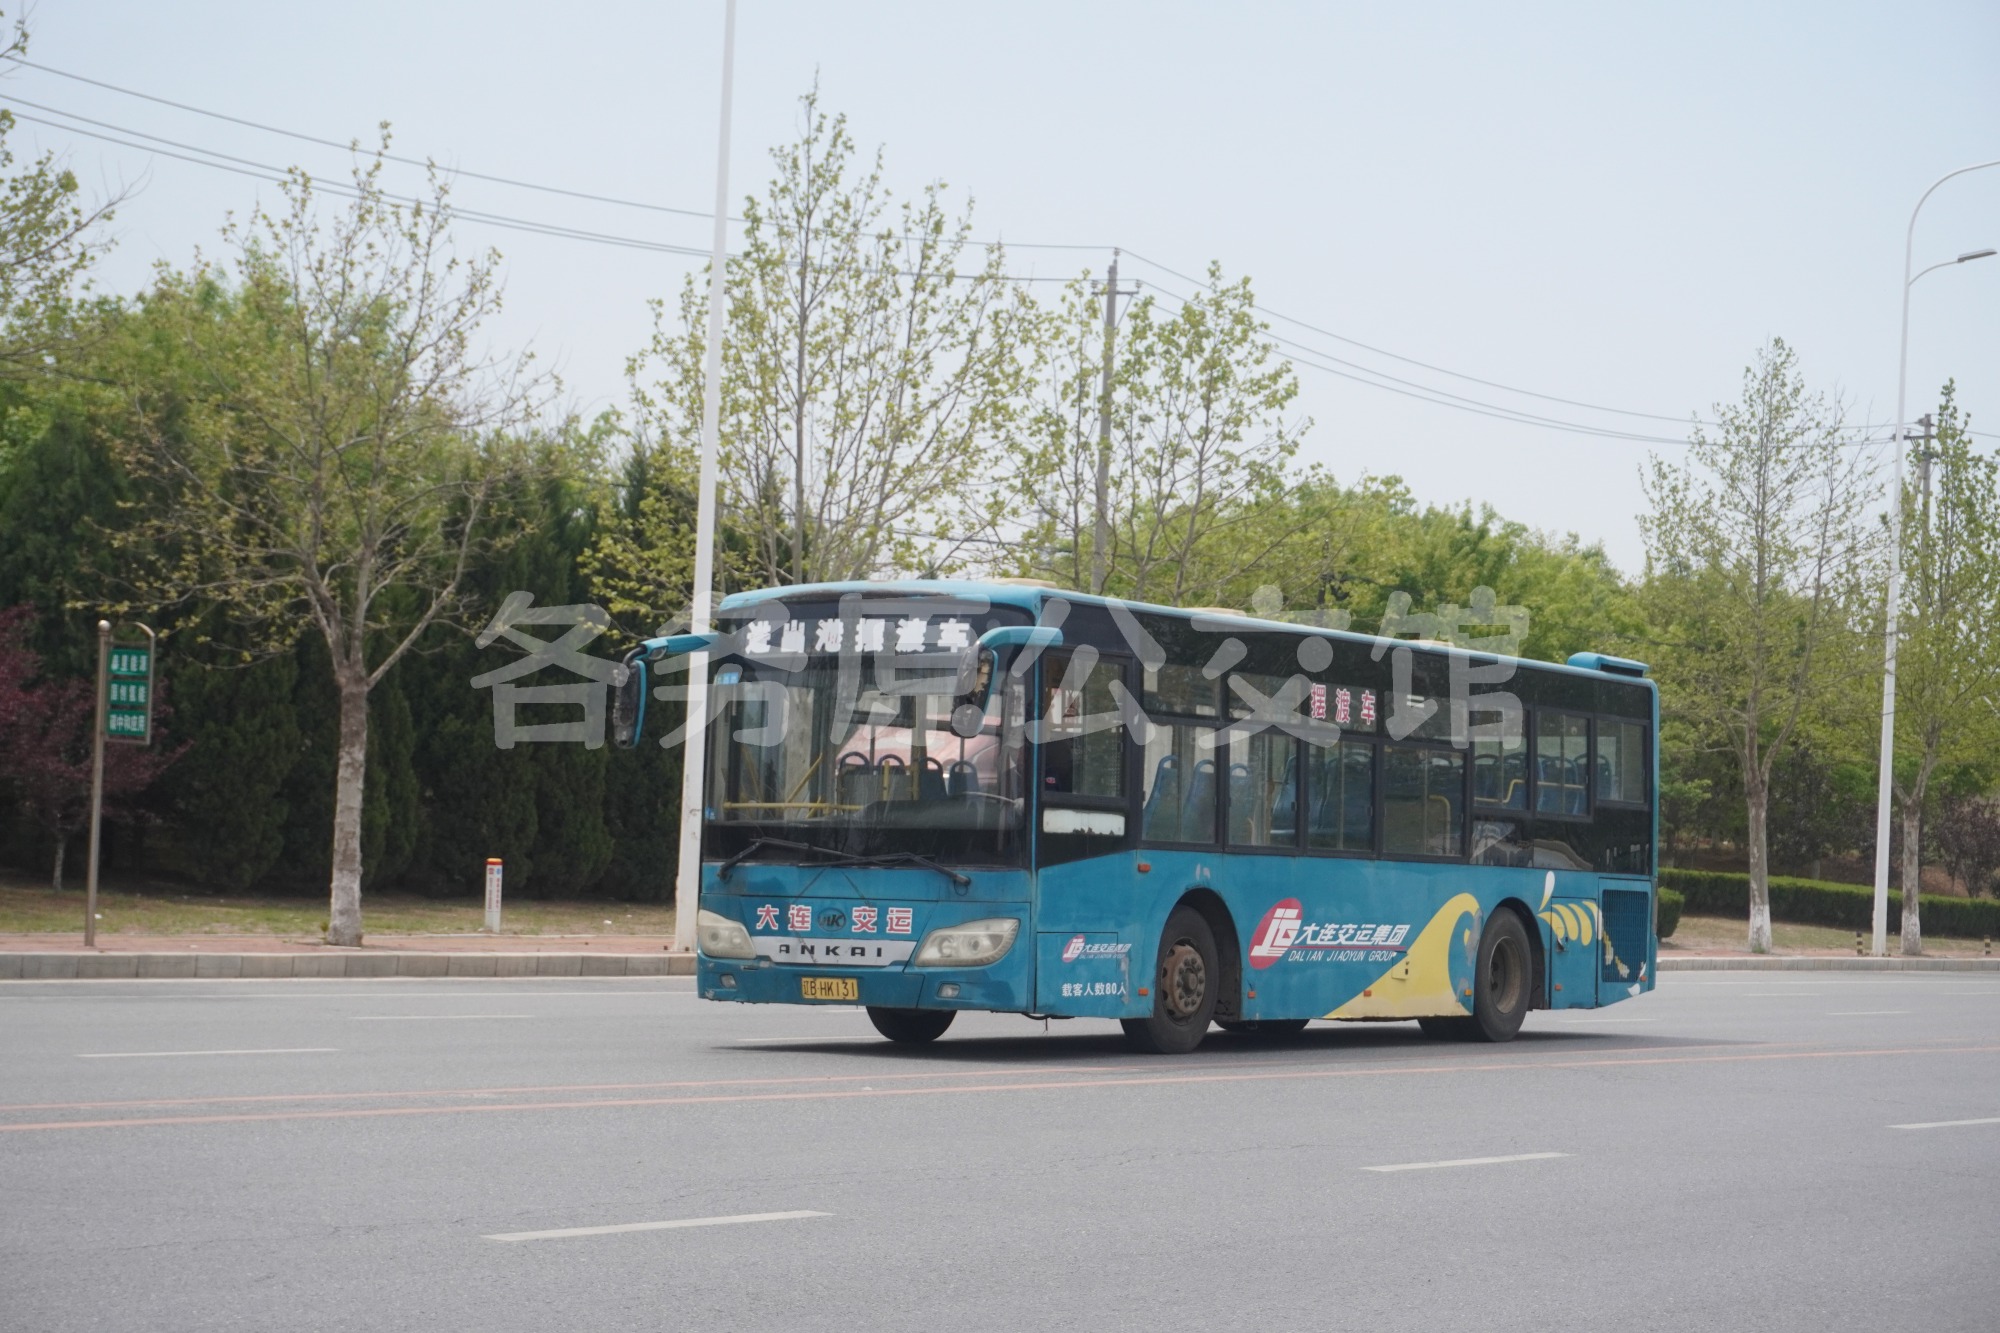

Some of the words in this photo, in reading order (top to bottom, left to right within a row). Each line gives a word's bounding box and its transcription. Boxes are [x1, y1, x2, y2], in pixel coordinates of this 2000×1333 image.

[1311, 683, 1376, 725] 摆渡车
[756, 904, 913, 934] 大连交运
[1294, 923, 1411, 945] 大连交运集团
[779, 944, 882, 957] ANKAI
[1288, 950, 1323, 962] DALIAN
[1326, 951, 1364, 962] JIAOYUN
[1061, 982, 1127, 997] 载客人数80人
